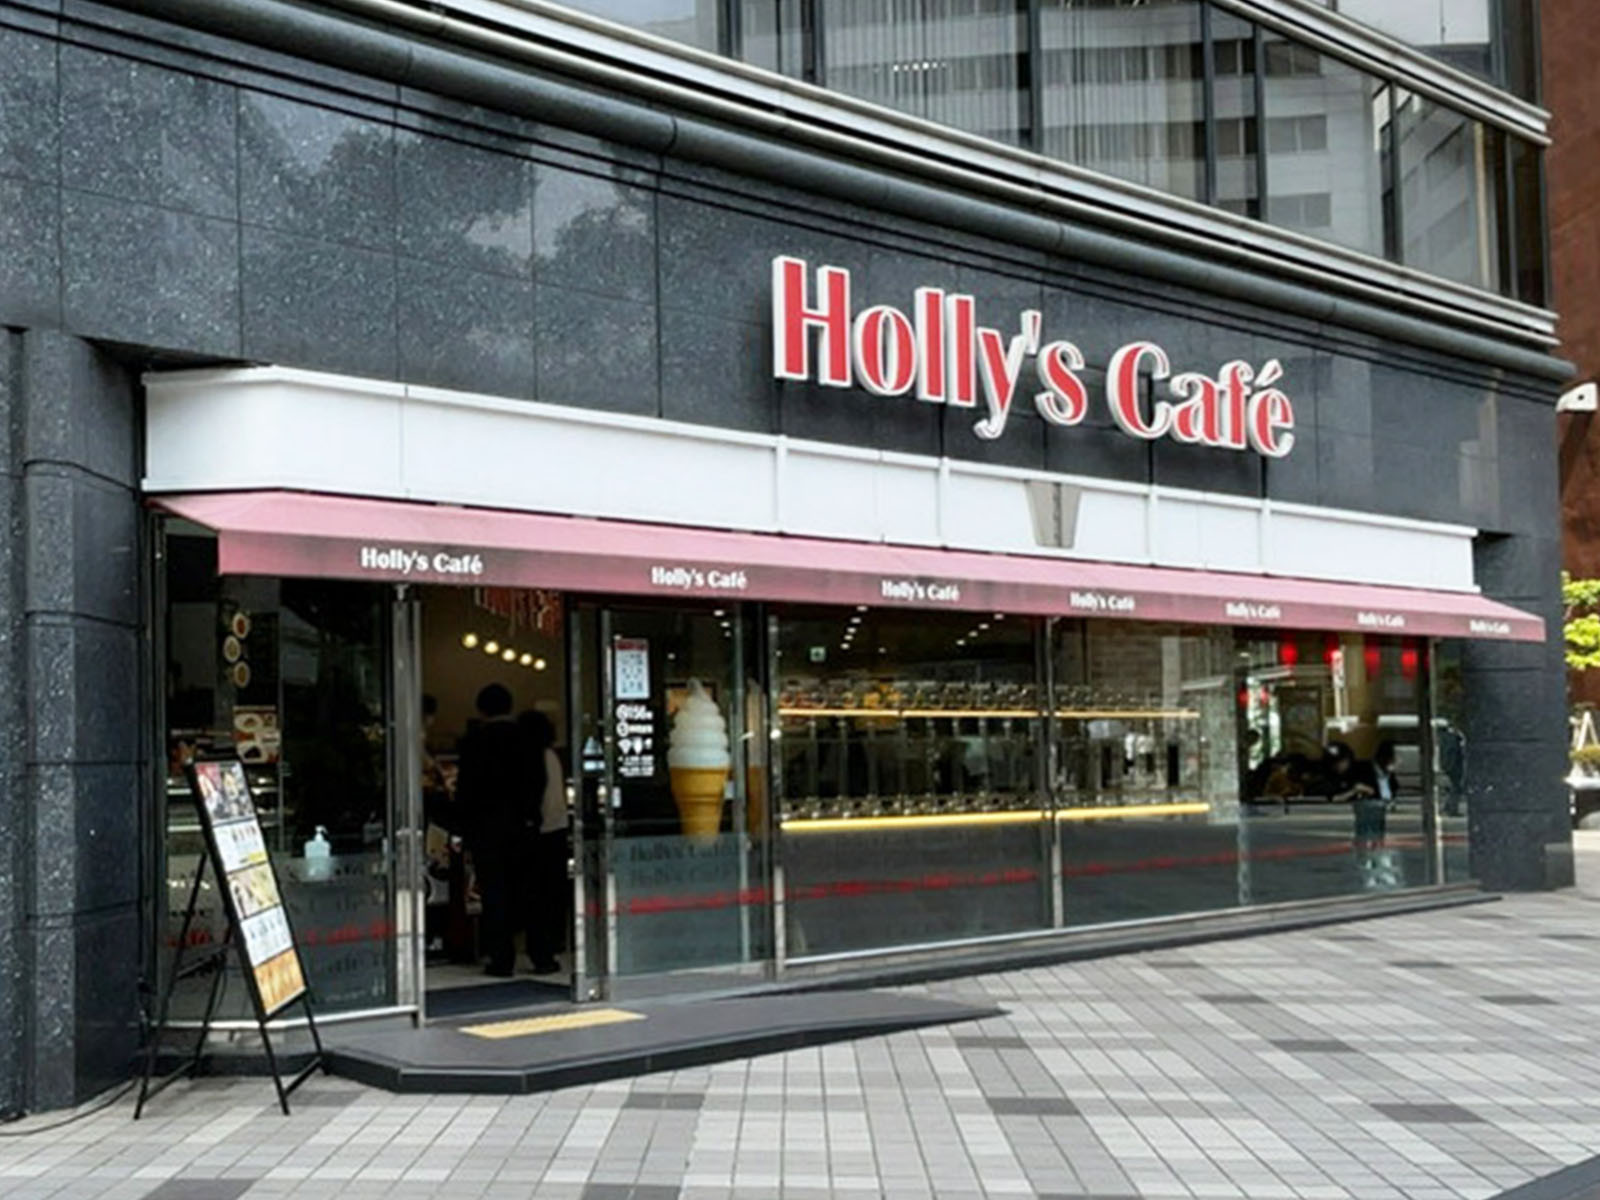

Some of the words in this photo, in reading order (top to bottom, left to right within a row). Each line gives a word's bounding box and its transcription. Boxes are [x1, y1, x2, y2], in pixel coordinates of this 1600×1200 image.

[773, 256, 1088, 440] Holly's
[1107, 341, 1295, 458] Café
[361, 547, 429, 574] Holly's
[433, 553, 483, 575] Café
[651, 567, 704, 589] Holly's
[707, 570, 748, 589] Café
[881, 580, 925, 601] Holly's
[927, 583, 960, 601] Café
[1108, 595, 1135, 611] Café
